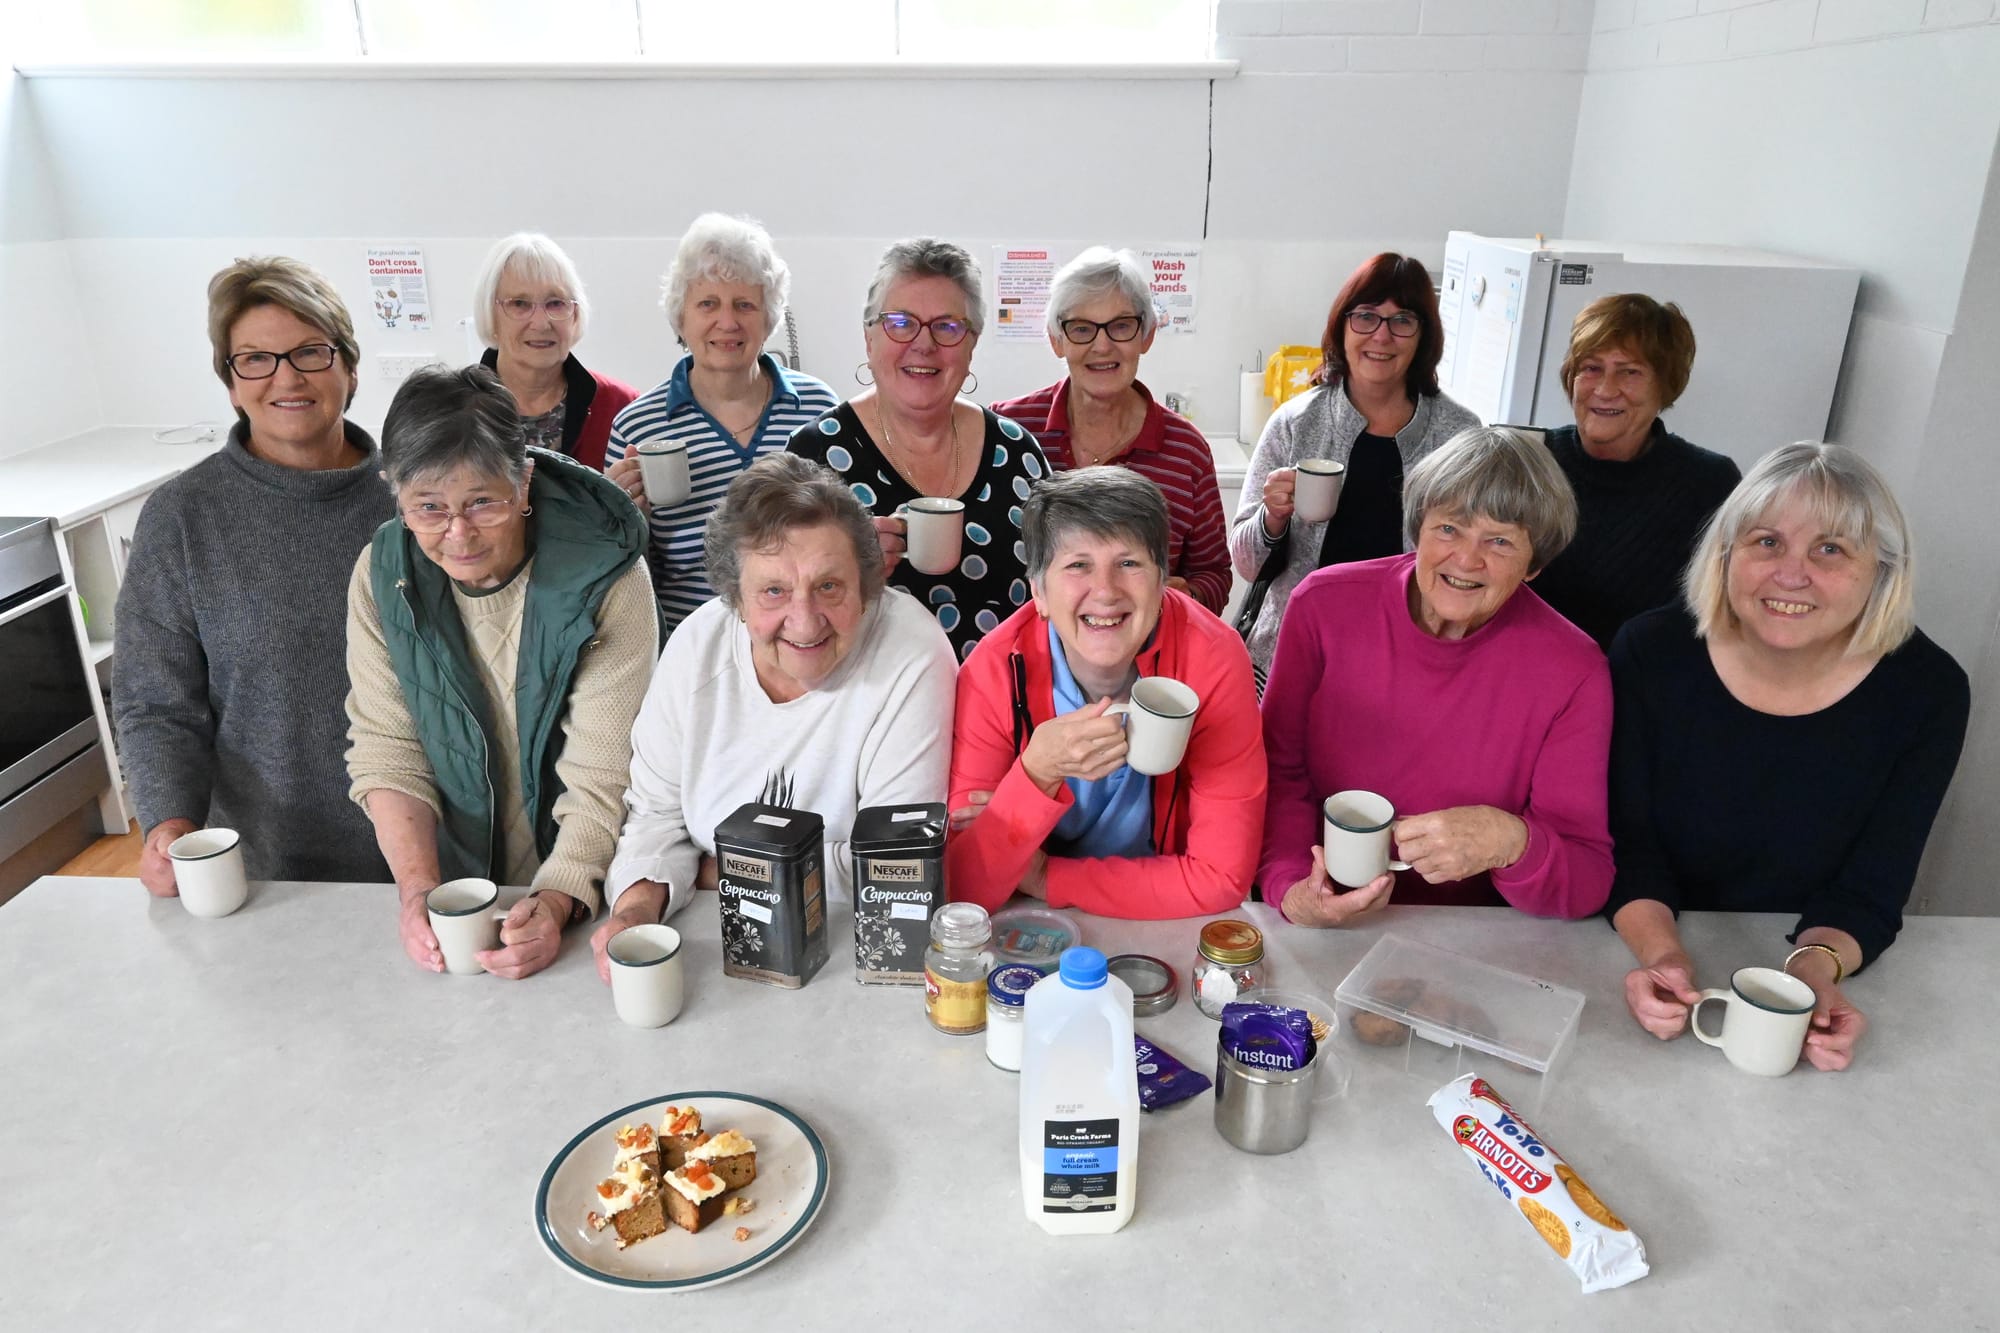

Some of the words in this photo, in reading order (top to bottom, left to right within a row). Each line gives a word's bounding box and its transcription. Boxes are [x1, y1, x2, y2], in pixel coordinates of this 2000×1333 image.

[368, 258, 391, 266] Don't
[1152, 260, 1185, 271] Wash
[369, 266, 423, 274] contaminate
[1154, 273, 1183, 283] your
[1149, 282, 1187, 292] hands
[726, 858, 767, 876] NESCAFÉ
[873, 864, 919, 876] NESCAFÉ
[718, 878, 781, 905] Cappuccino
[861, 885, 933, 904] Cappuccino
[1233, 1043, 1294, 1070] Instant
[1065, 1152, 1095, 1161] organic
[1469, 1128, 1543, 1189] ARNOTT'S
